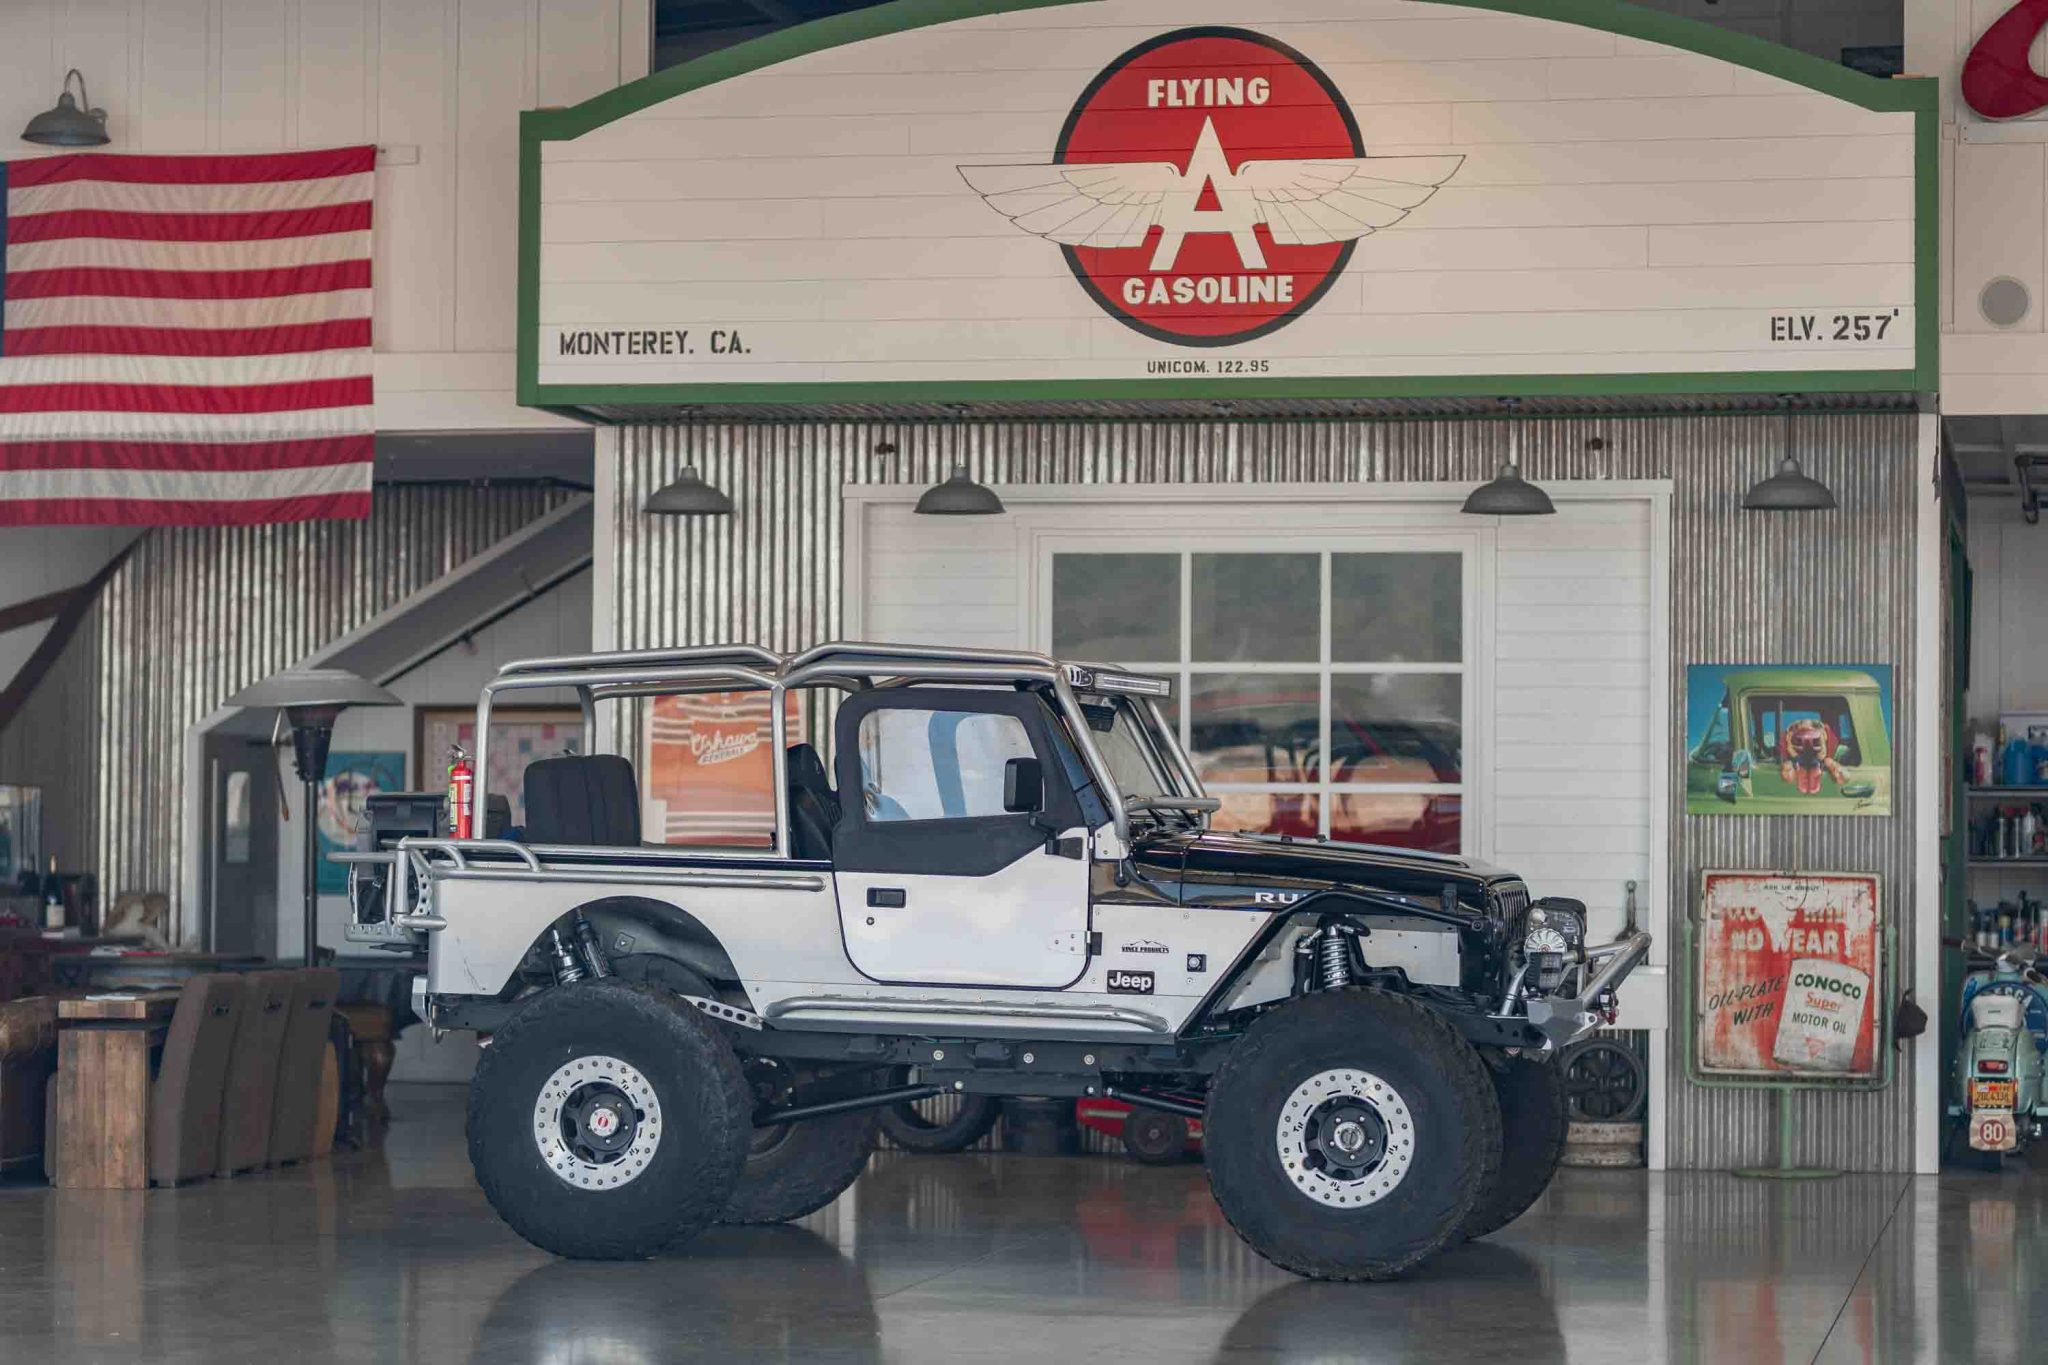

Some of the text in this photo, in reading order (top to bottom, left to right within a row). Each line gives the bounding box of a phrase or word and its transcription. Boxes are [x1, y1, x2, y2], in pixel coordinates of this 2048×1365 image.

[1147, 77, 1271, 107] FLYING
[1123, 275, 1294, 305] GASOLINE
[1771, 316, 1823, 341] ELV.
[560, 330, 752, 355] MONTEREY. CA.
[1147, 360, 1270, 374] UNICOM. 122.95
[1731, 927, 1764, 951] NO
[1108, 972, 1152, 992] Jeep
[1708, 975, 1785, 1011] OIL-PLATE
[1794, 973, 1862, 1000] CONOCO
[1733, 1002, 1775, 1027] WITH
[1792, 1012, 1847, 1035] MOTOR OIL
[1983, 1123, 2003, 1142] 80
